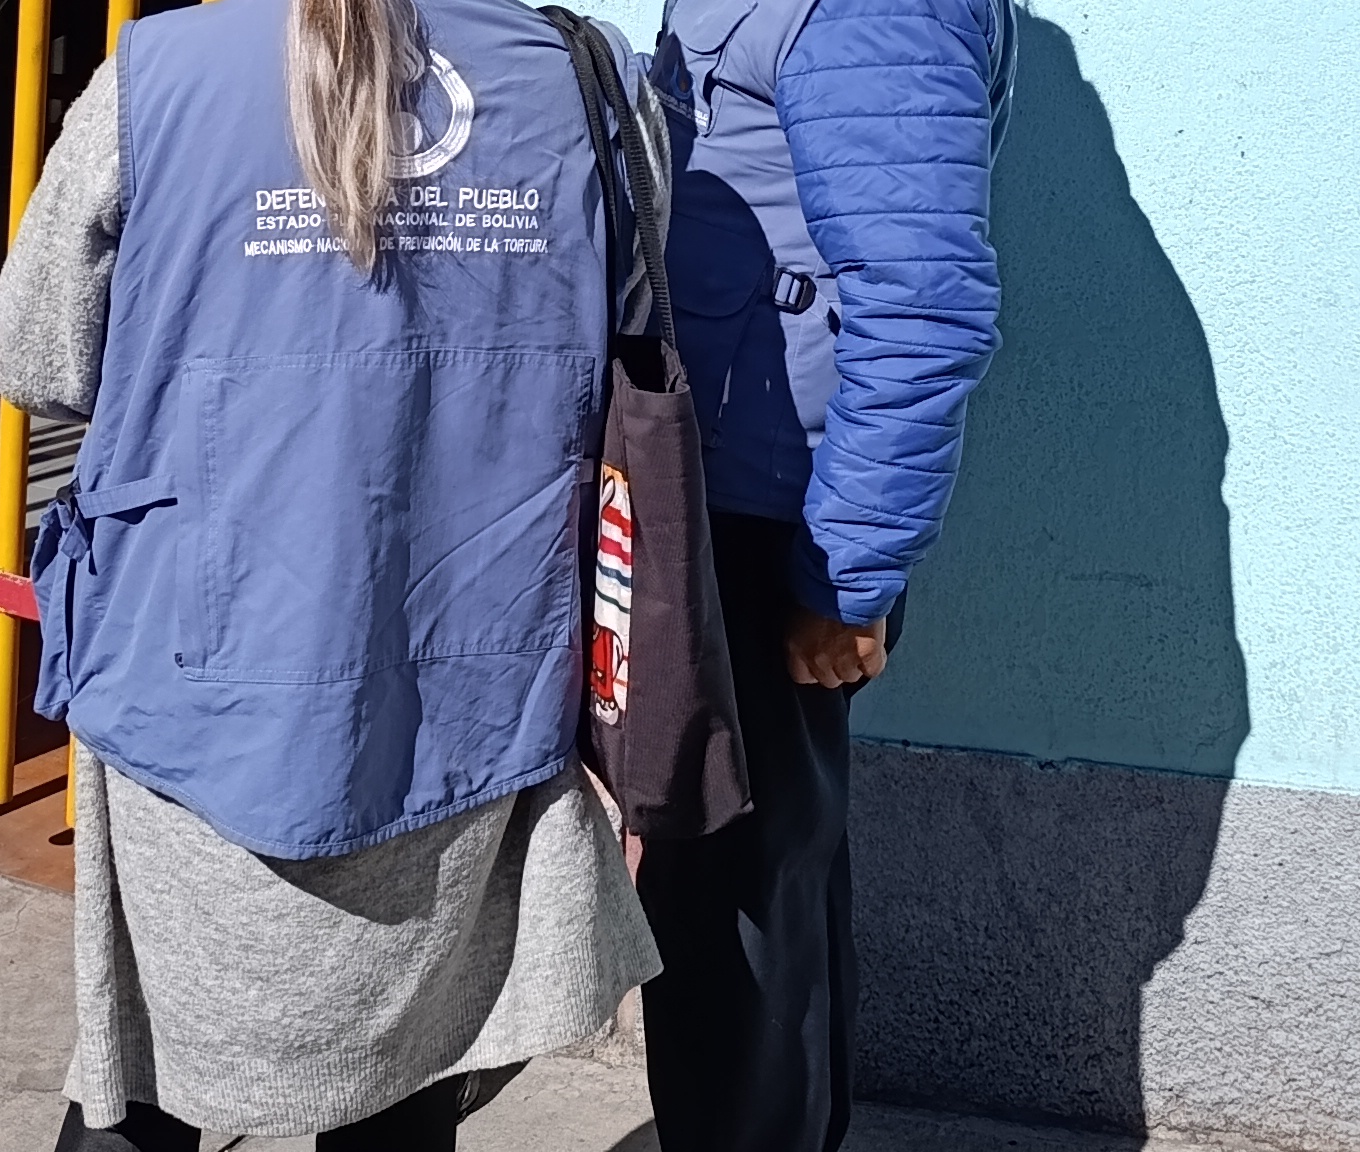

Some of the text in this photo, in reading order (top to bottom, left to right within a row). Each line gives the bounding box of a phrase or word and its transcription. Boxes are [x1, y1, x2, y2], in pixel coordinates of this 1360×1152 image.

[255, 185, 540, 211] DEFENA DEL PUEBLO
[256, 213, 322, 230] ESTADO
[455, 213, 477, 227] DE
[482, 214, 539, 230] BOLIVIA
[244, 237, 312, 257] MECANISMO
[379, 236, 395, 251] DE
[398, 231, 463, 253] PREVENCIÓN
[466, 237, 482, 253] DE
[484, 237, 499, 253] LA
[503, 238, 549, 254] TORTURA
